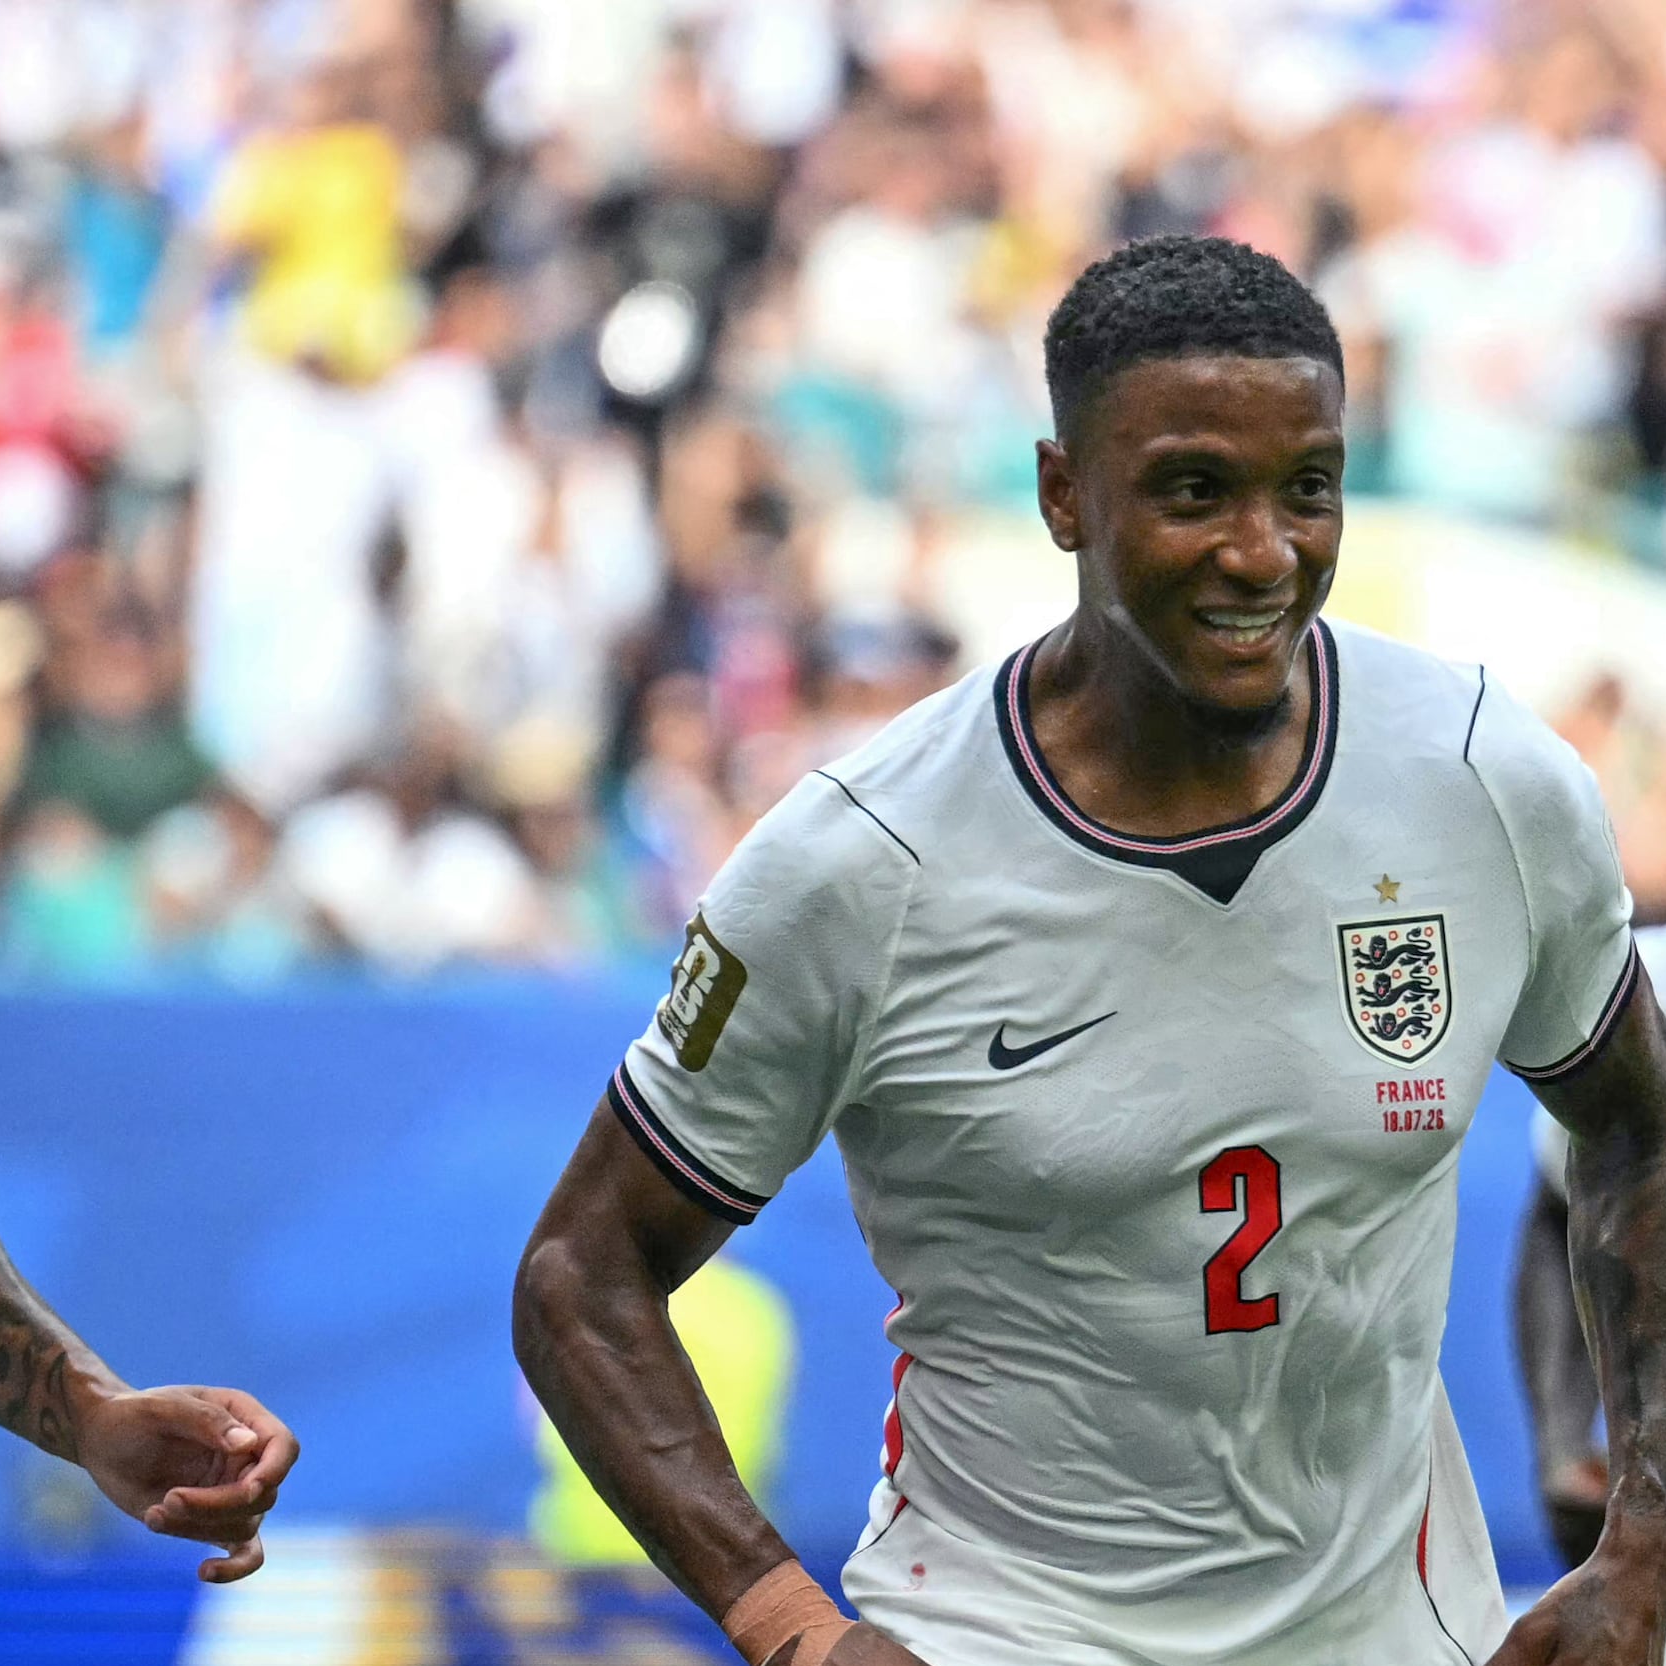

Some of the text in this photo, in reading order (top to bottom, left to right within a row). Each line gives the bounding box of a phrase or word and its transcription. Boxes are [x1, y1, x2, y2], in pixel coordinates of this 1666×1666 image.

[1376, 1078, 1446, 1103] FRANCE
[1383, 1109, 1444, 1133] 18.07.26
[1199, 1145, 1282, 1335] 2
